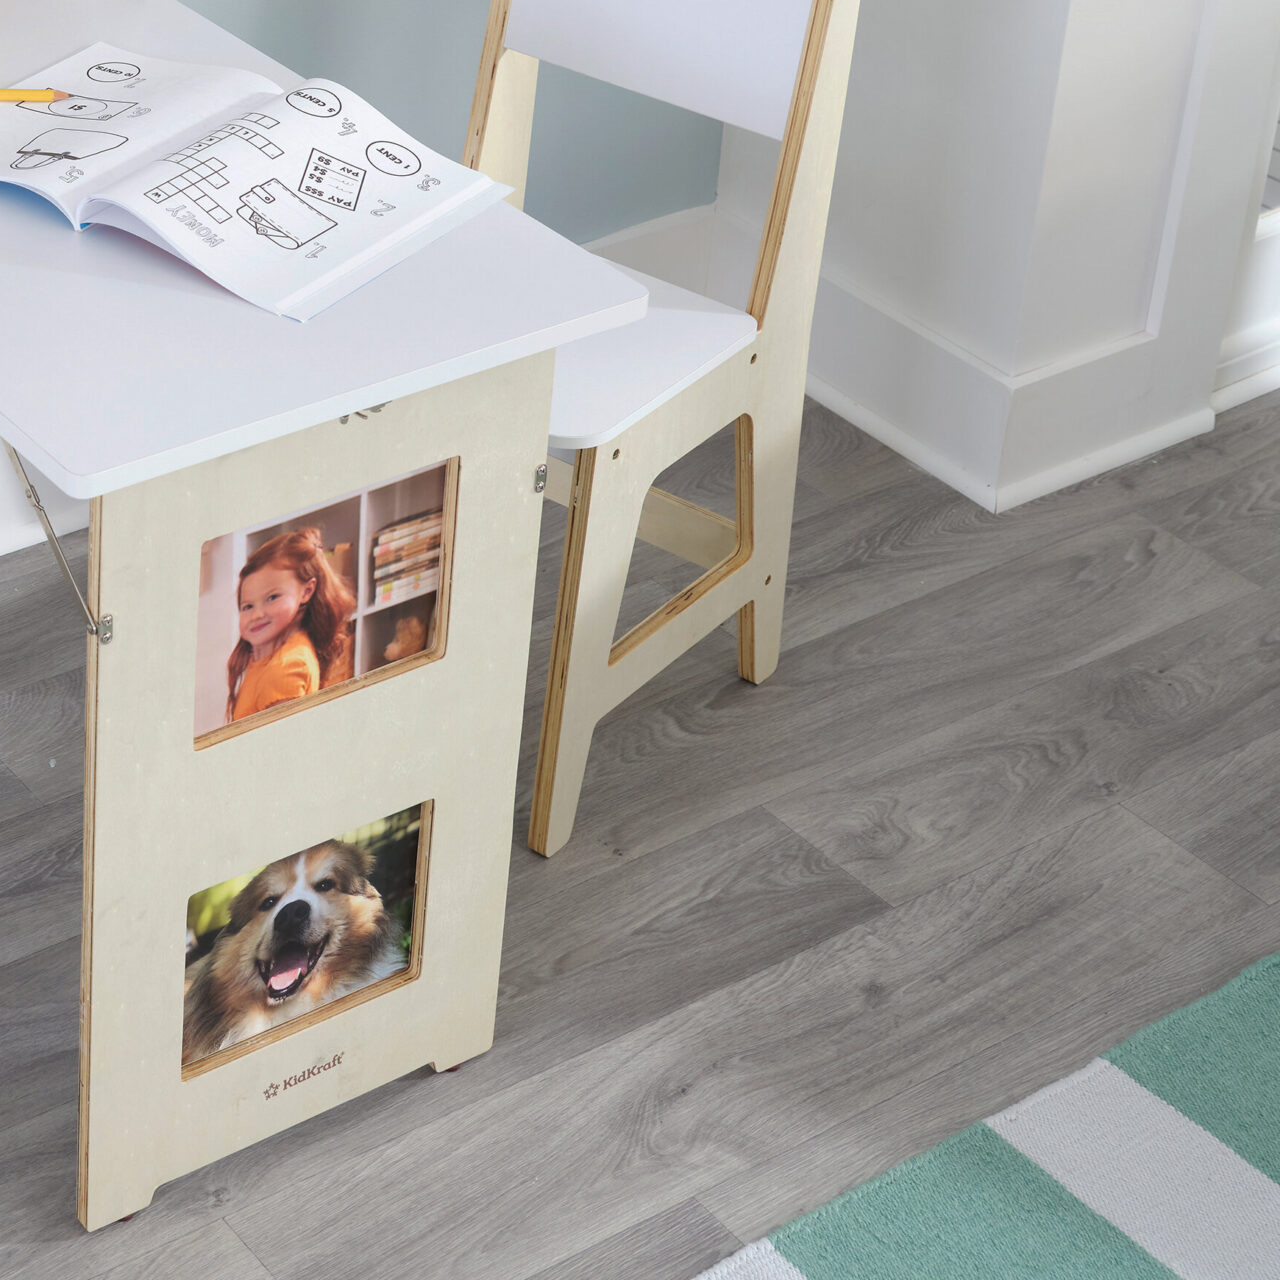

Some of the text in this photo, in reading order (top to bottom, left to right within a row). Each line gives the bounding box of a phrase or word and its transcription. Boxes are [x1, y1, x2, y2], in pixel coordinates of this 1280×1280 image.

[294, 91, 326, 107] CENTS
[376, 147, 403, 165] CENT
[340, 166, 360, 177] PAY
[328, 195, 352, 208] PAY
[165, 204, 225, 248] MONEY
[283, 1053, 342, 1091] KidKraft
